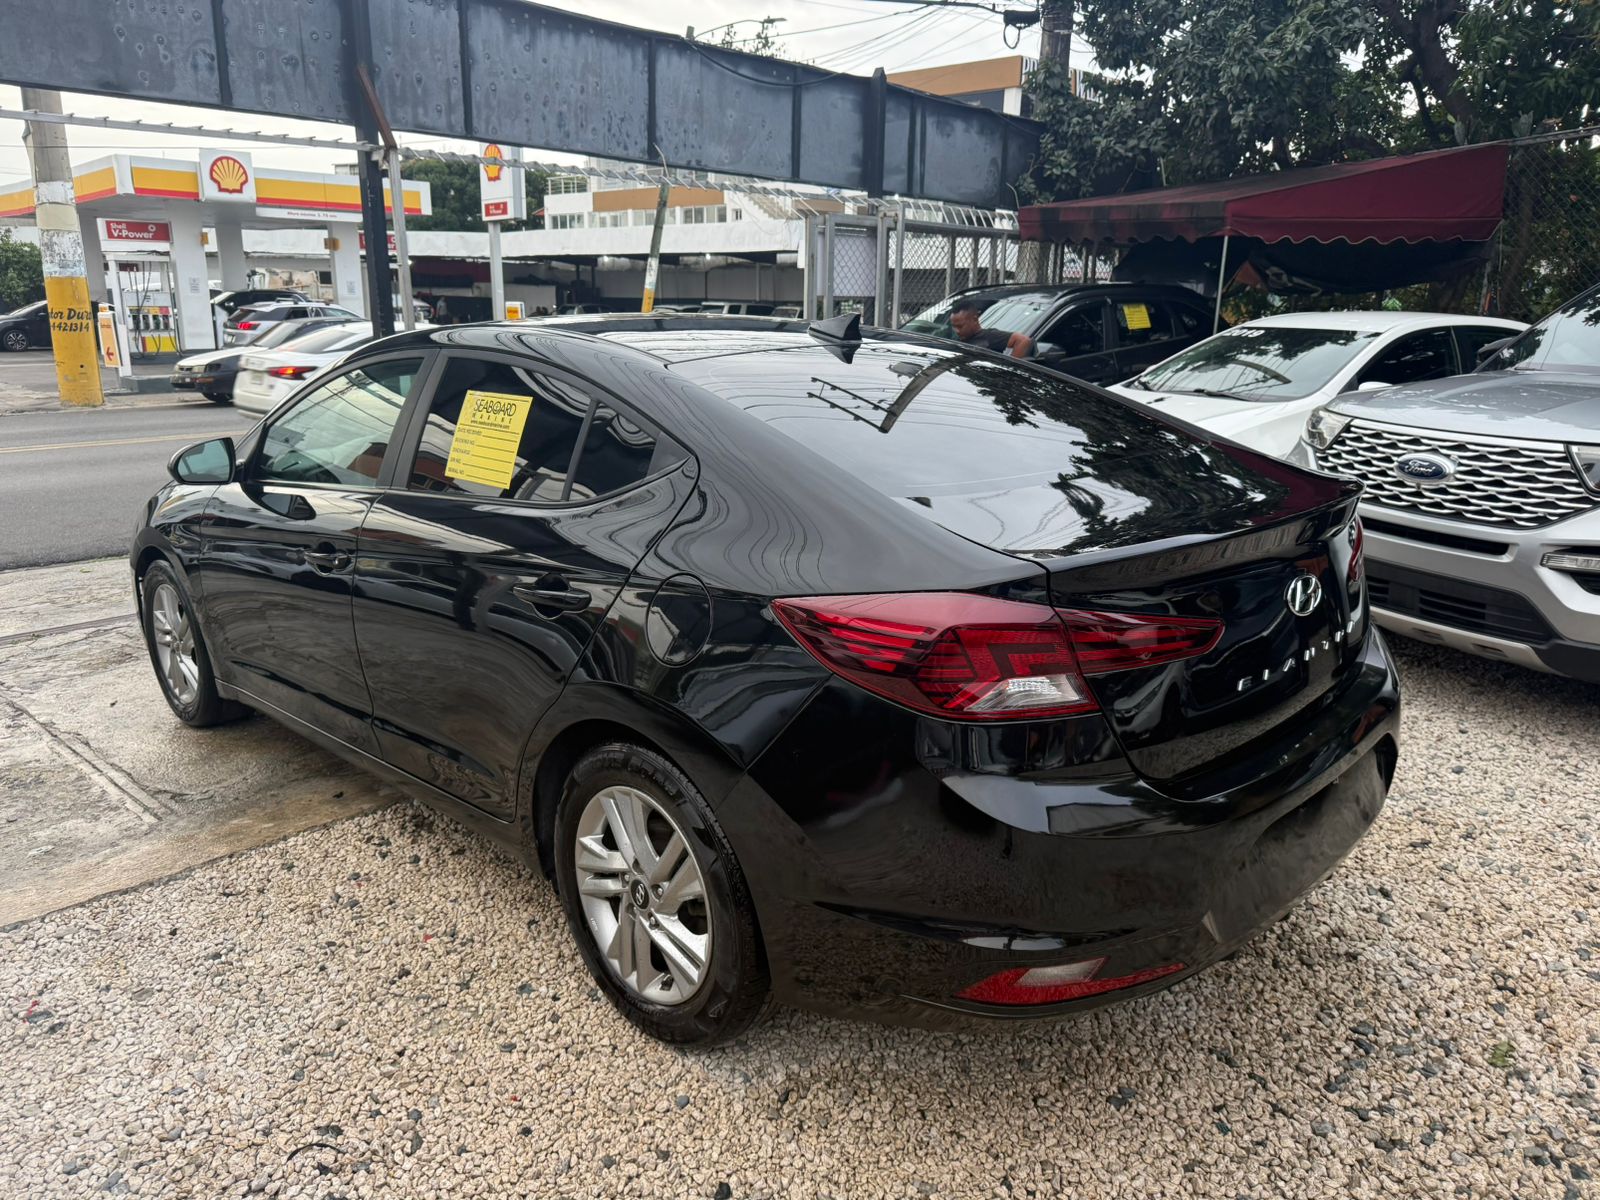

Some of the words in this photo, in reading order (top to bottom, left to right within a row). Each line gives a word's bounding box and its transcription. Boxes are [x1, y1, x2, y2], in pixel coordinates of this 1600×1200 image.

[111, 229, 154, 239] V-Power
[474, 398, 517, 417] SEABOARD
[472, 412, 512, 424] MARINE
[1404, 459, 1436, 474] Ford
